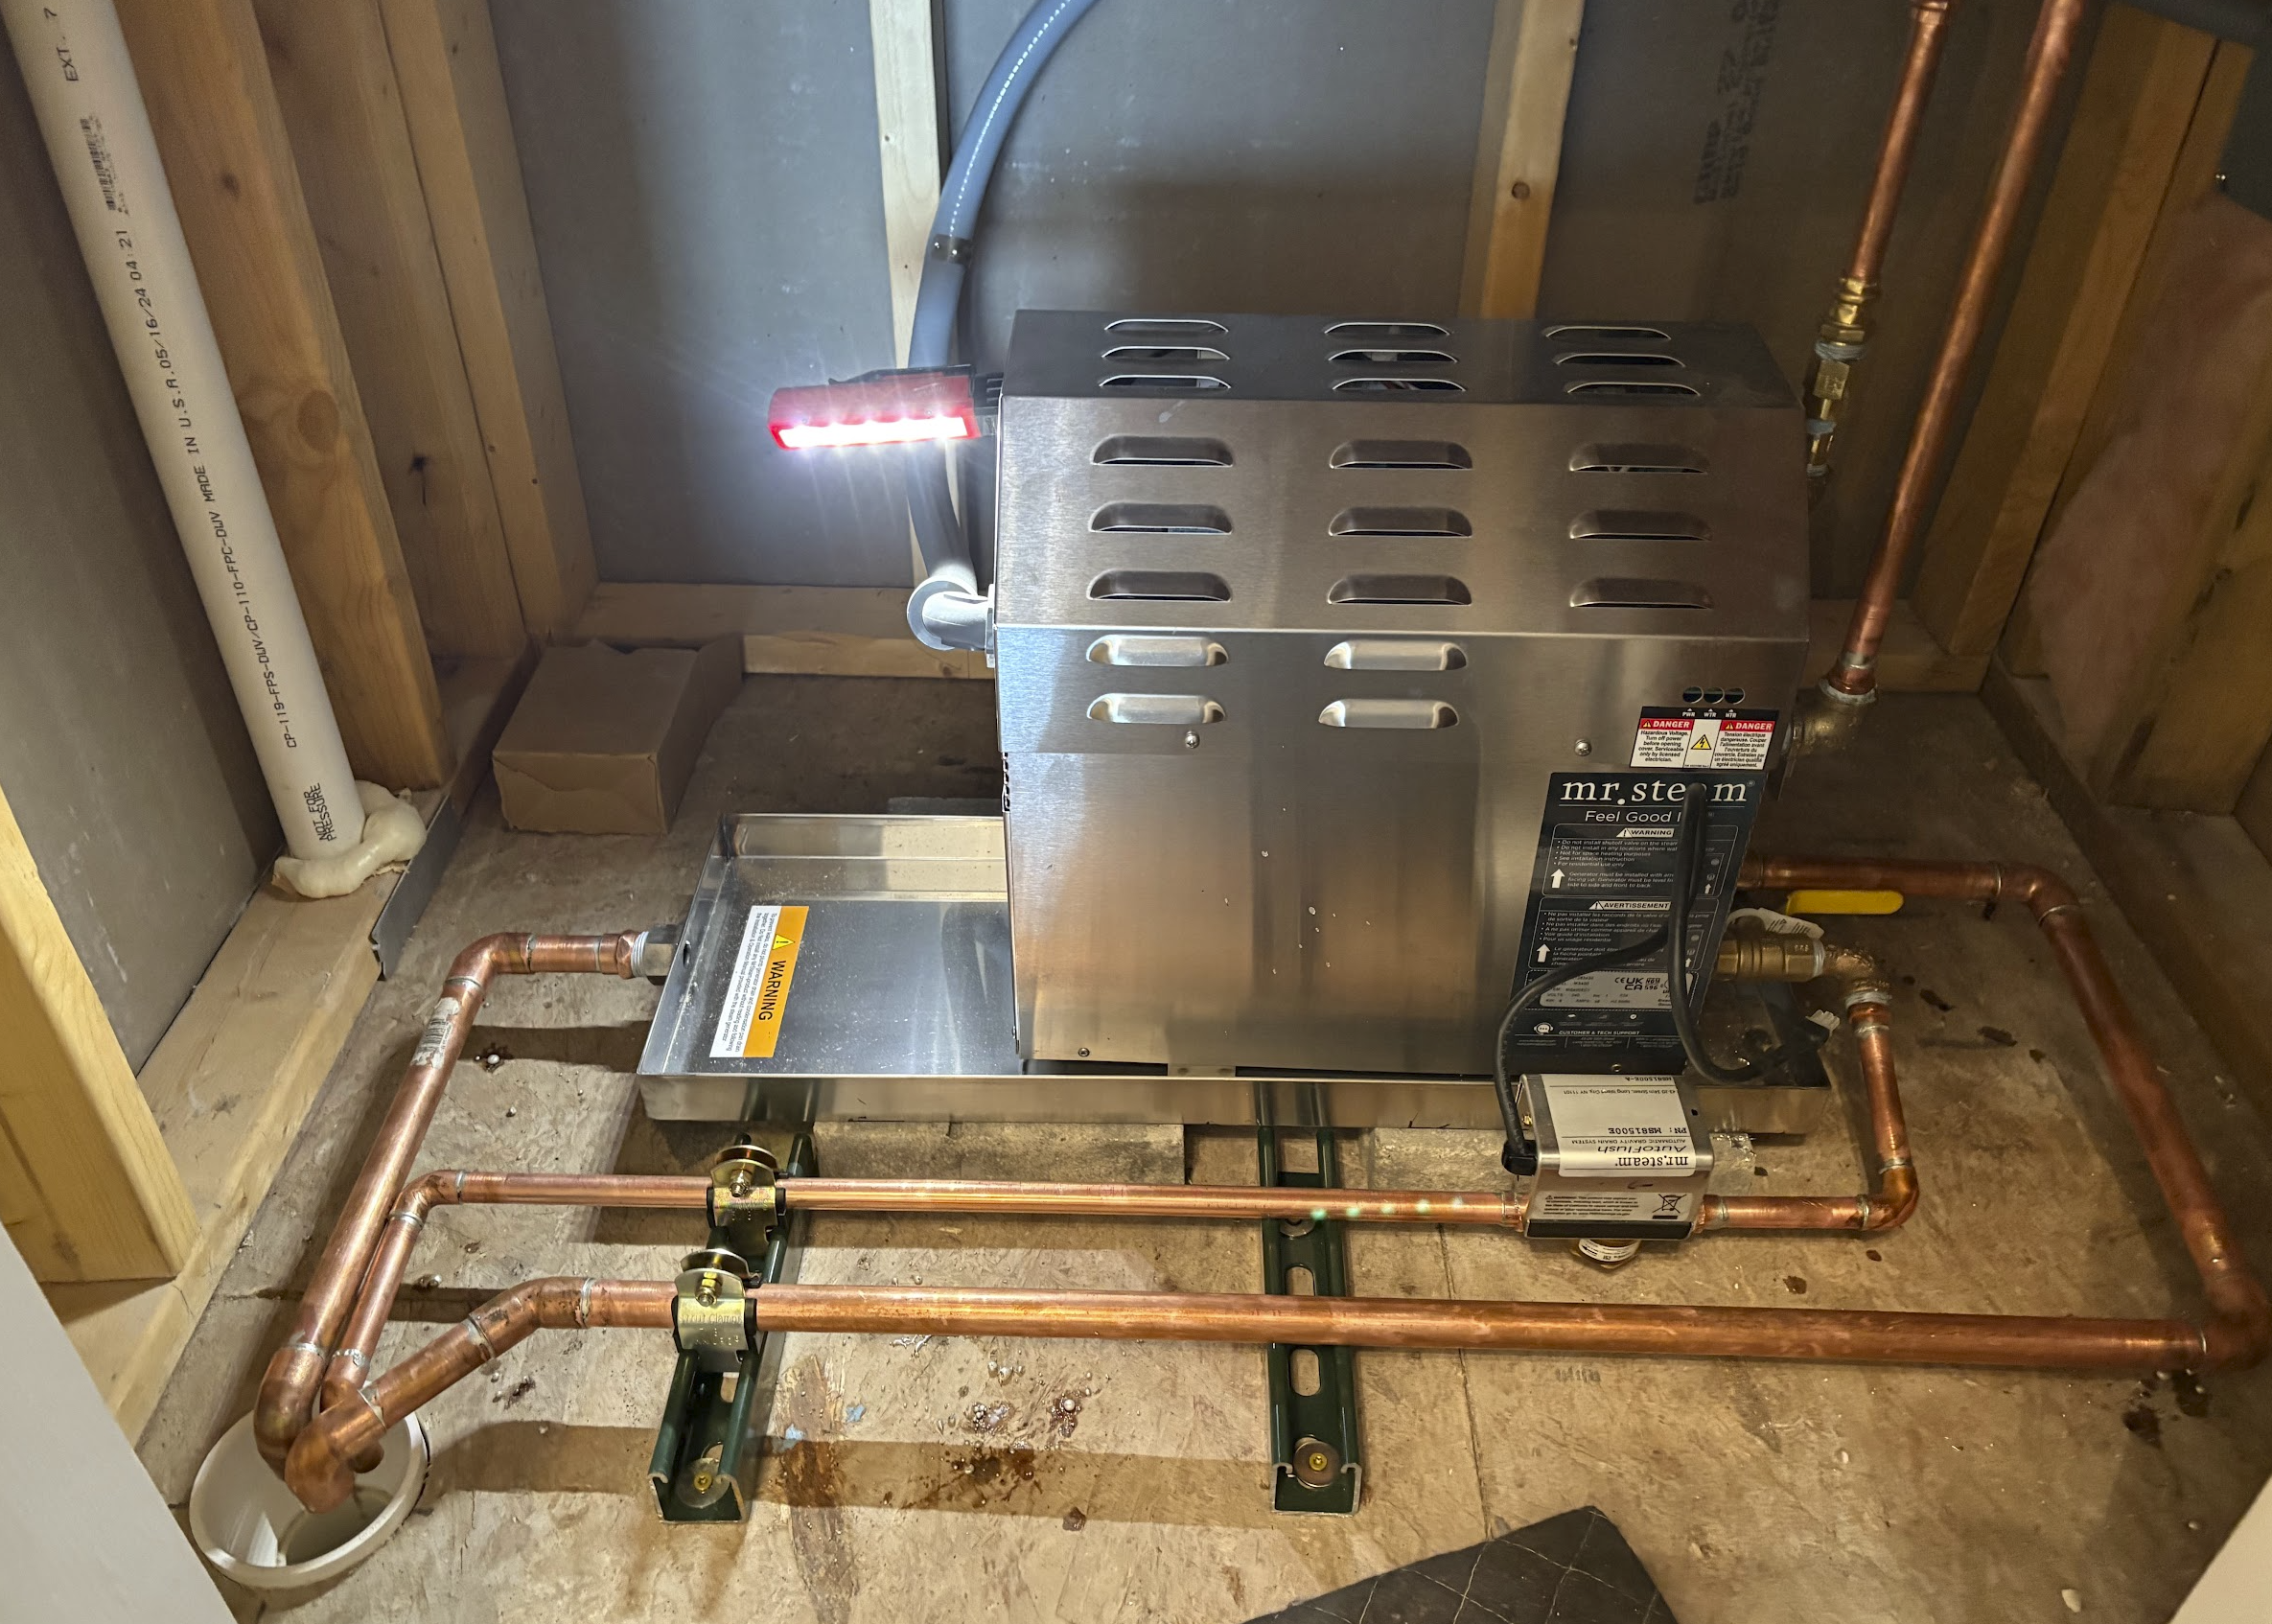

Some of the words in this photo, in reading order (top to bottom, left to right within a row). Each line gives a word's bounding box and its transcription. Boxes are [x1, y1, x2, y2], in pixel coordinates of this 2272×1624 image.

[115, 230, 142, 281] 04:21
[184, 437, 199, 454] IN
[194, 465, 215, 502] MADE
[303, 790, 319, 814] FOR
[1560, 780, 1747, 805] mr.stem
[309, 782, 337, 843] PRESSURE
[1585, 811, 1620, 822] Feel
[1626, 811, 1671, 822] Good
[313, 819, 327, 842] NOT
[752, 919, 760, 938] Installation
[745, 942, 754, 960] Operation
[740, 962, 749, 975] Manual
[759, 961, 786, 1020] WARNING
[733, 1009, 742, 1024] reading
[726, 1033, 737, 1051] following
[1618, 1155, 1688, 1167] mr.steam
